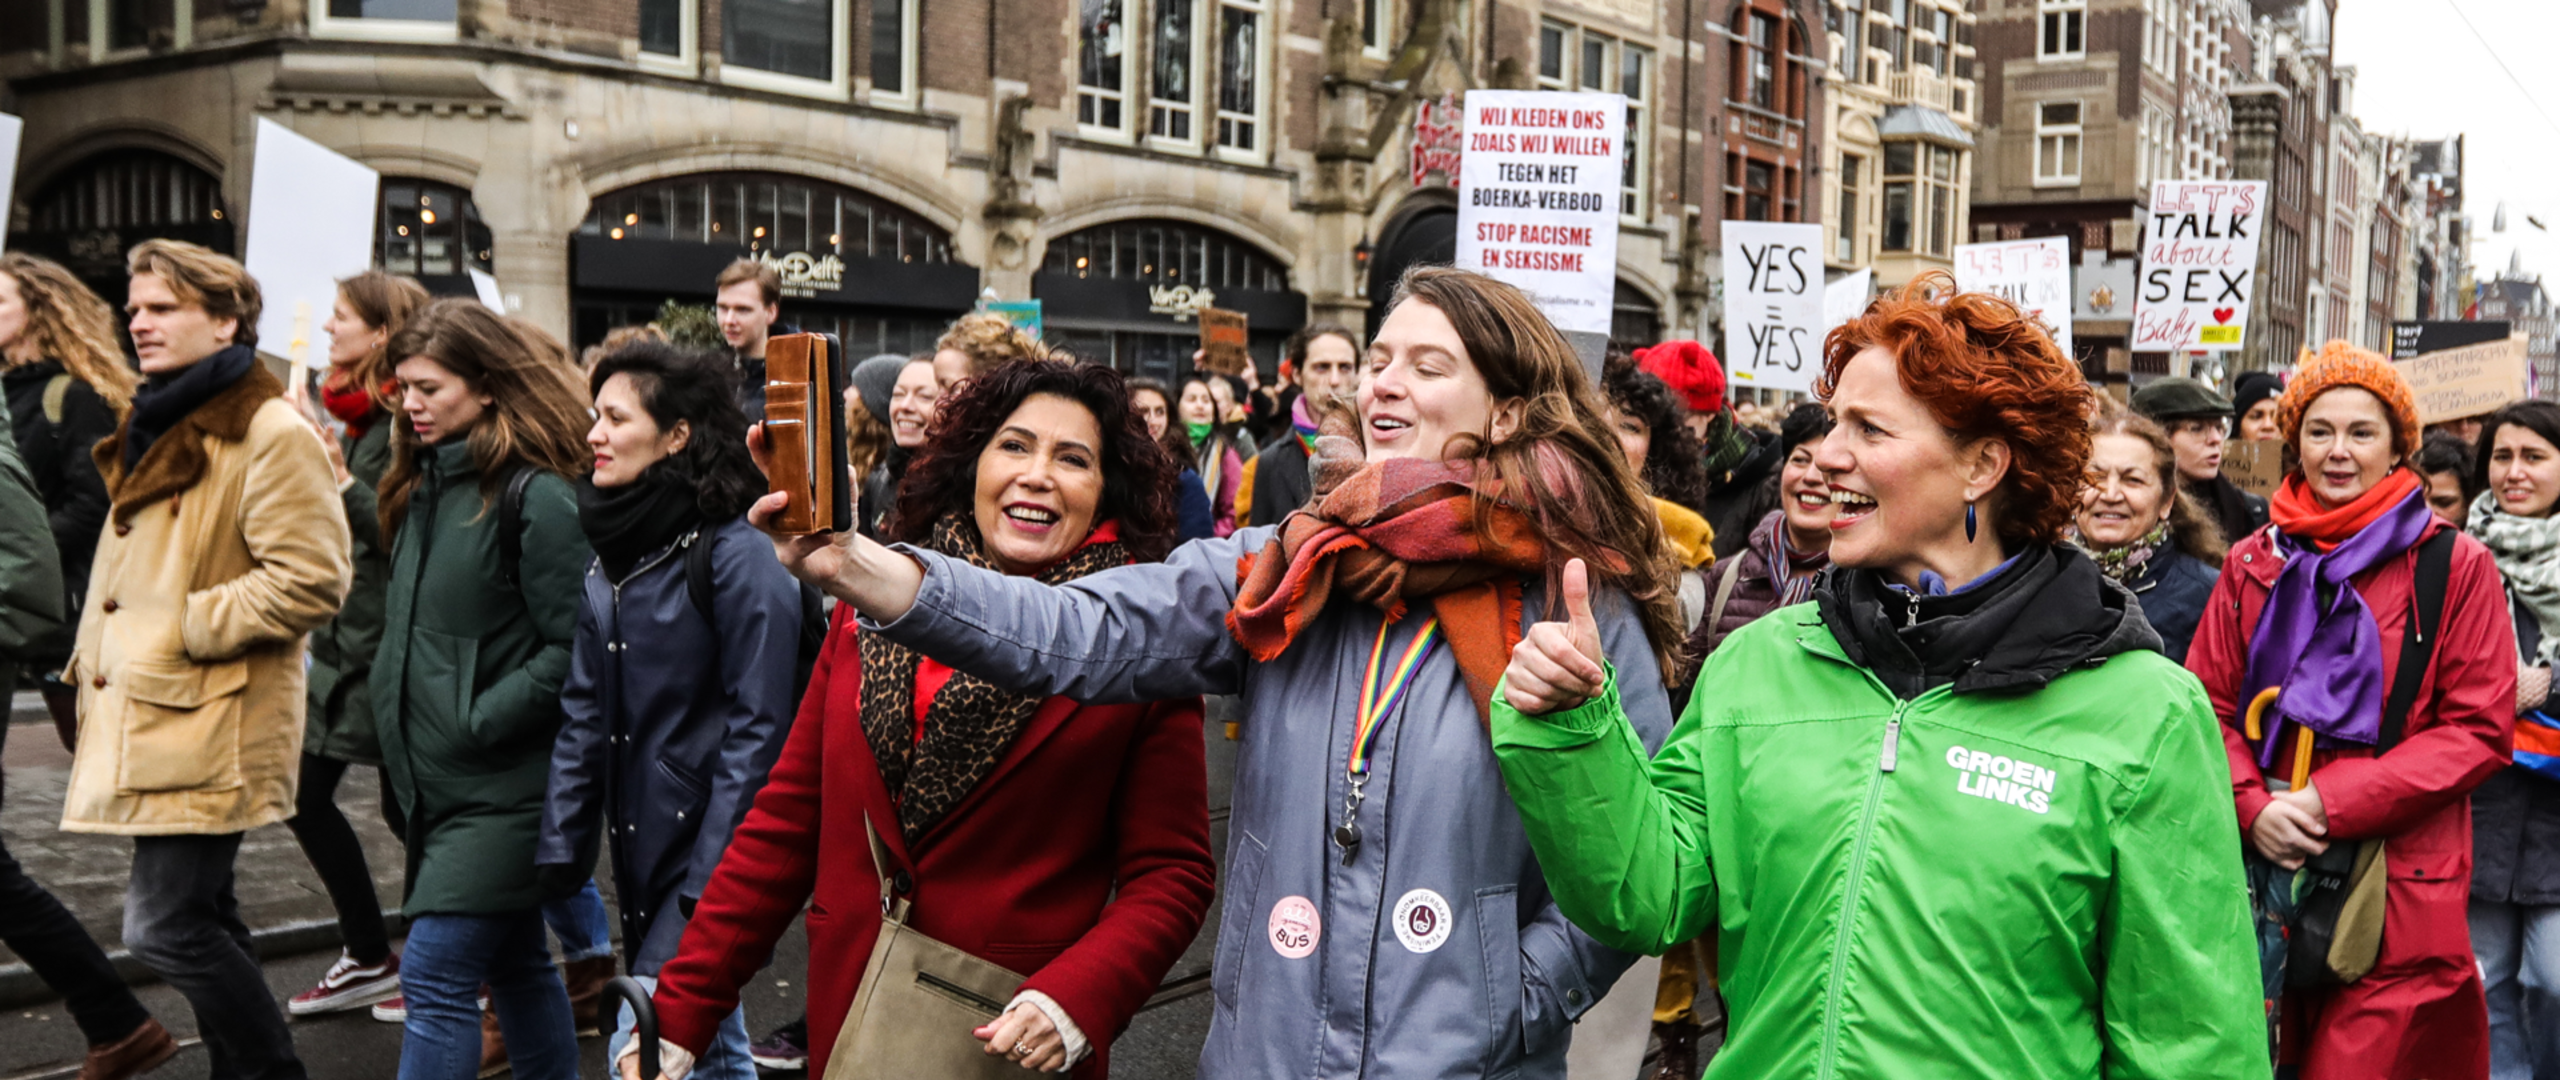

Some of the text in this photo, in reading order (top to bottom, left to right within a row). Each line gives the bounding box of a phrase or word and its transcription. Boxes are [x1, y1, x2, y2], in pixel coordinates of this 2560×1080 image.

[1480, 107, 1506, 126] WIJ
[1511, 108, 1568, 128] KLEDEN
[1573, 110, 1605, 130] ONS
[1471, 133, 1611, 156] ZOALS WIJ WILLEN
[1499, 162, 1578, 184] TEGEN HET
[1472, 188, 1603, 212] BOERKA-VERBOD
[2156, 184, 2257, 214] LET'S
[1477, 222, 1592, 247] STOP RACISME
[2154, 213, 2252, 239] TALK
[1483, 249, 1584, 273] EN SEKSISME
[2151, 240, 2234, 265] about
[783, 252, 847, 281] Delft
[1740, 242, 1807, 295] YES
[2145, 269, 2248, 303] SEX
[2137, 307, 2196, 350] Baby
[1748, 323, 1808, 372] YES
[1946, 745, 2056, 793] GROEN
[1957, 771, 2050, 814] LINKS
[1276, 927, 1309, 948] BUS
